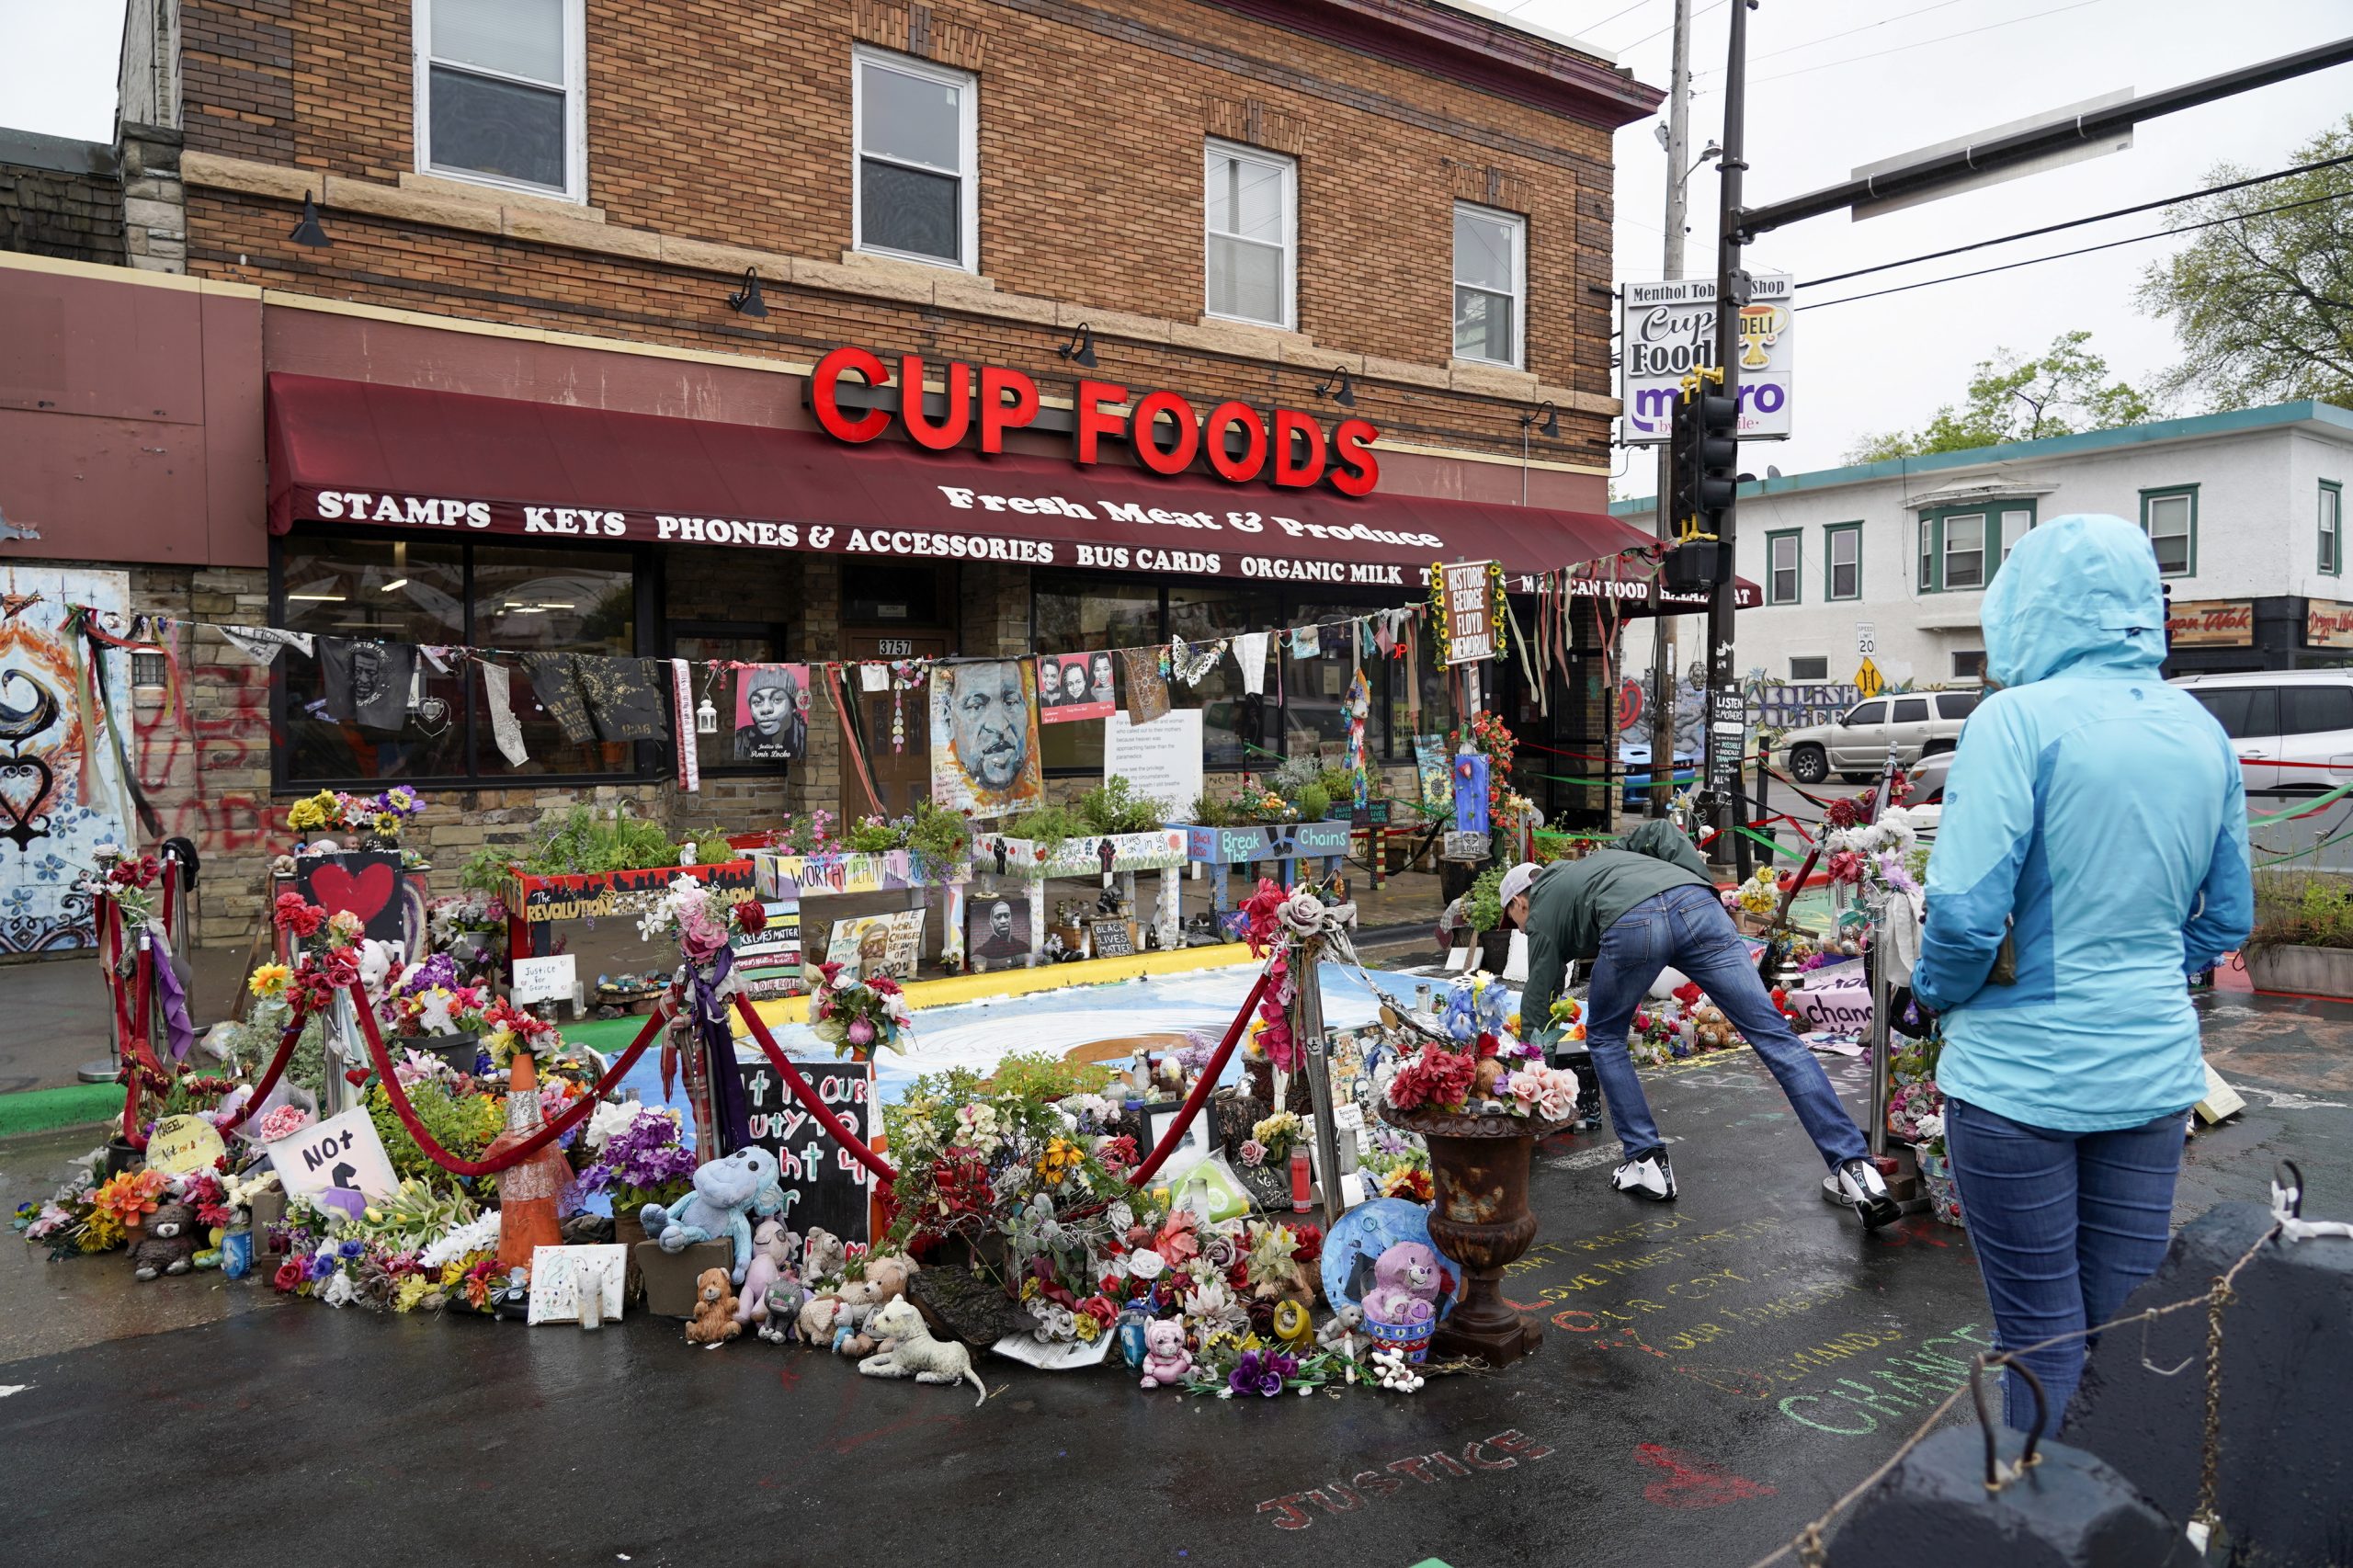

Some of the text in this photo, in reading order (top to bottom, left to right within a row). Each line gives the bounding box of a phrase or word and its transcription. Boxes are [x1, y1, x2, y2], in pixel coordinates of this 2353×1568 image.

[1633, 284, 1686, 301] Menthol
[1752, 280, 1785, 295] Shop
[1641, 306, 1717, 346] Cup
[1740, 316, 1772, 335] DELI
[1631, 340, 1713, 373] Food
[1636, 383, 1784, 417] mro
[805, 346, 1379, 497] CUP FOODS
[938, 485, 1445, 550] Fresh Meat & Produce
[317, 491, 491, 528] STAMPS
[524, 506, 626, 536] KEYS
[654, 516, 799, 548] PHONES
[808, 525, 835, 549] &
[846, 528, 1054, 563] ACCESSORIES
[1076, 544, 1130, 570] BUS
[1135, 548, 1221, 574] CARDS
[1240, 556, 1345, 582] ORGANIC
[1348, 564, 1403, 585] MILK
[1605, 581, 1648, 599] FOOD
[1448, 566, 1486, 591] HISTORIC
[1452, 588, 1483, 612] GEORGE
[1456, 612, 1483, 636] FLOYD
[2201, 607, 2250, 631] Wok
[881, 641, 910, 654] 3757
[1450, 633, 1492, 660] MEMORIAL
[1859, 640, 1874, 653] 20
[1716, 697, 1744, 710] LISTEN
[1746, 685, 1861, 705] ABOLISH
[1720, 710, 1744, 721] MOTHERS
[1746, 709, 1848, 728] POLICE
[770, 750, 791, 758] Locke
[1722, 742, 1742, 750] POSSIBLE
[1121, 835, 1142, 846] Lives
[1222, 829, 1347, 850] Break Chains
[1224, 848, 1248, 863] The
[790, 862, 848, 889] WORTHY
[853, 859, 899, 884] BEAUTIFUL
[532, 891, 551, 904] The
[527, 898, 614, 922] REVOLUTION
[892, 910, 919, 921] THE
[773, 927, 798, 940] MATTER
[892, 920, 920, 932] WORLD
[1096, 923, 1126, 934] BLACK
[888, 942, 919, 952] BECAUSE
[889, 932, 921, 943] CHANGED
[1097, 934, 1127, 944] LIVES
[894, 950, 907, 959] OF
[1100, 944, 1132, 954] MATTER
[525, 966, 556, 976] Justice
[819, 1075, 868, 1105] OUR
[748, 1108, 808, 1141] uty
[1256, 1428, 1555, 1530] JUSTICE
